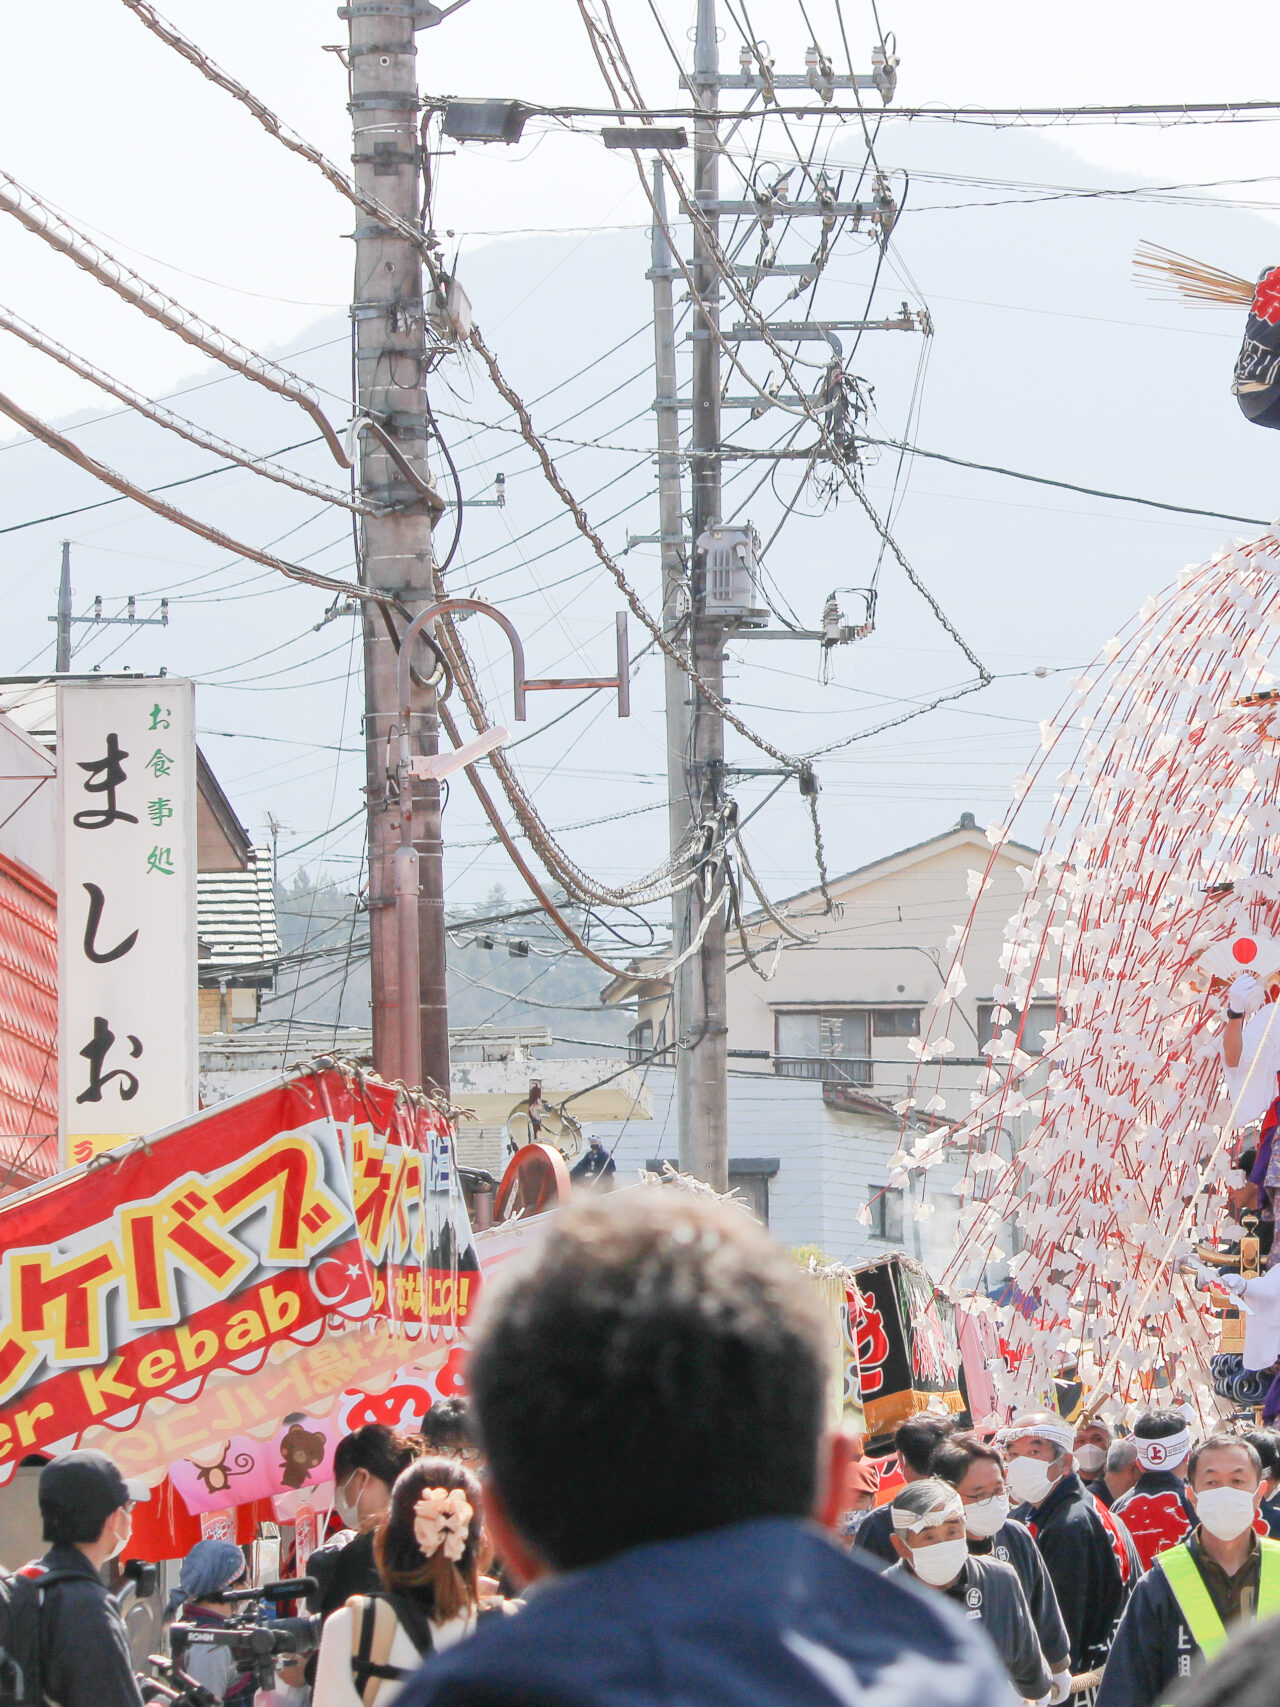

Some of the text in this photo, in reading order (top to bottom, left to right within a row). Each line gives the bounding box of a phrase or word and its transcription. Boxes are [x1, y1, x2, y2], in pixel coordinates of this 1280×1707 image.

[145, 703, 175, 876] お食事処
[73, 733, 143, 1105] ましお
[79, 1284, 301, 1416] Kebab
[187, 1632, 214, 1642] RONIN
